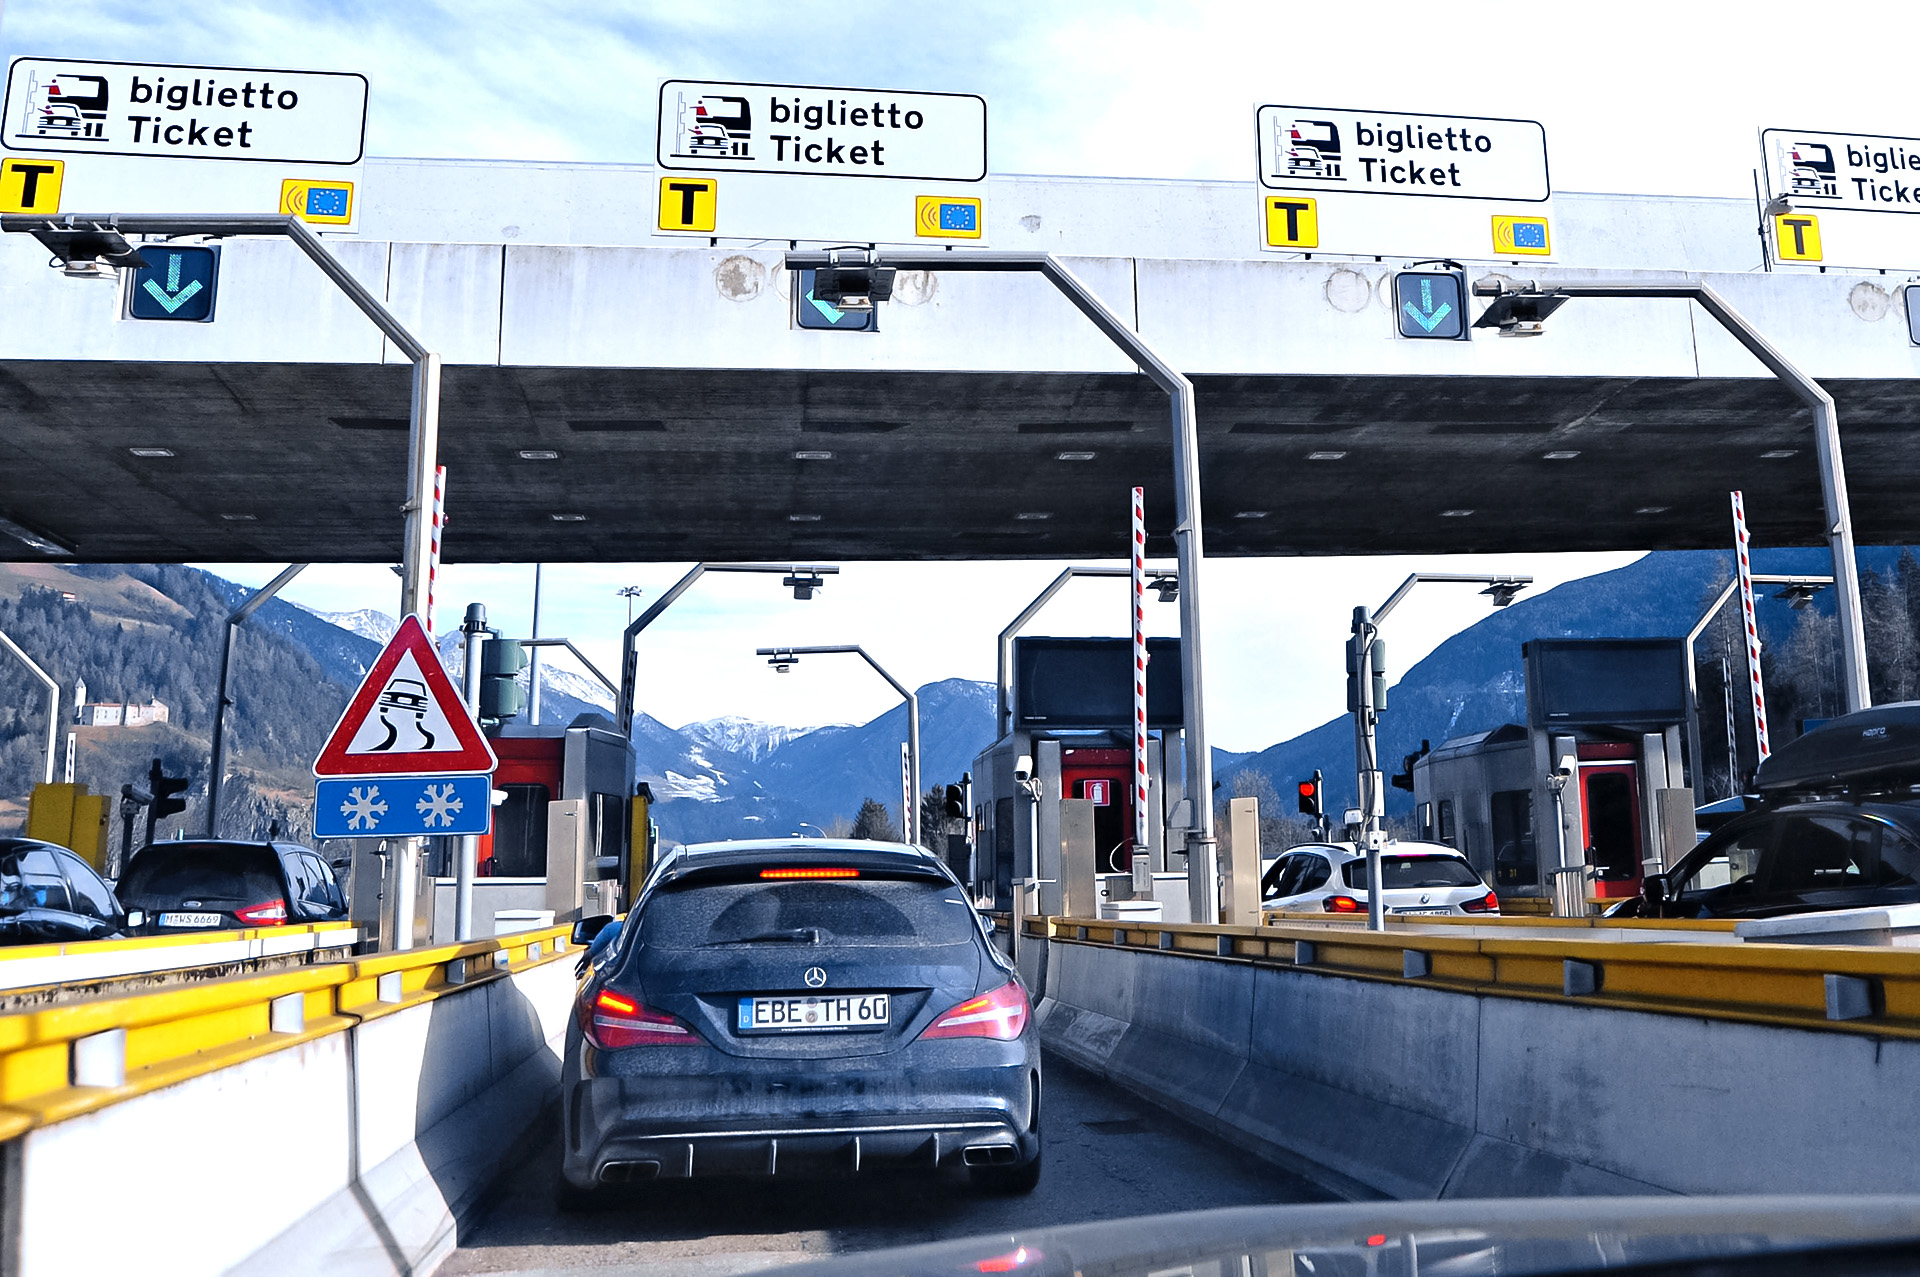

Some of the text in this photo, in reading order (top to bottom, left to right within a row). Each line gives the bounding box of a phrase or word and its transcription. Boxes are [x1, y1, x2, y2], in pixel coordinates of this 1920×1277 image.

[129, 75, 300, 112] biglietto
[770, 97, 924, 131] biglietto
[127, 115, 253, 148] Ticket
[1356, 121, 1492, 154] biglietto
[769, 134, 885, 166] Ticket
[11, 164, 55, 208] T
[1358, 157, 1461, 187] Ticket
[669, 183, 709, 225] T
[1274, 202, 1309, 242] T
[1782, 219, 1812, 255] T
[755, 1000, 802, 1024] EBE
[820, 998, 851, 1022] TH
[858, 997, 887, 1021] 60
